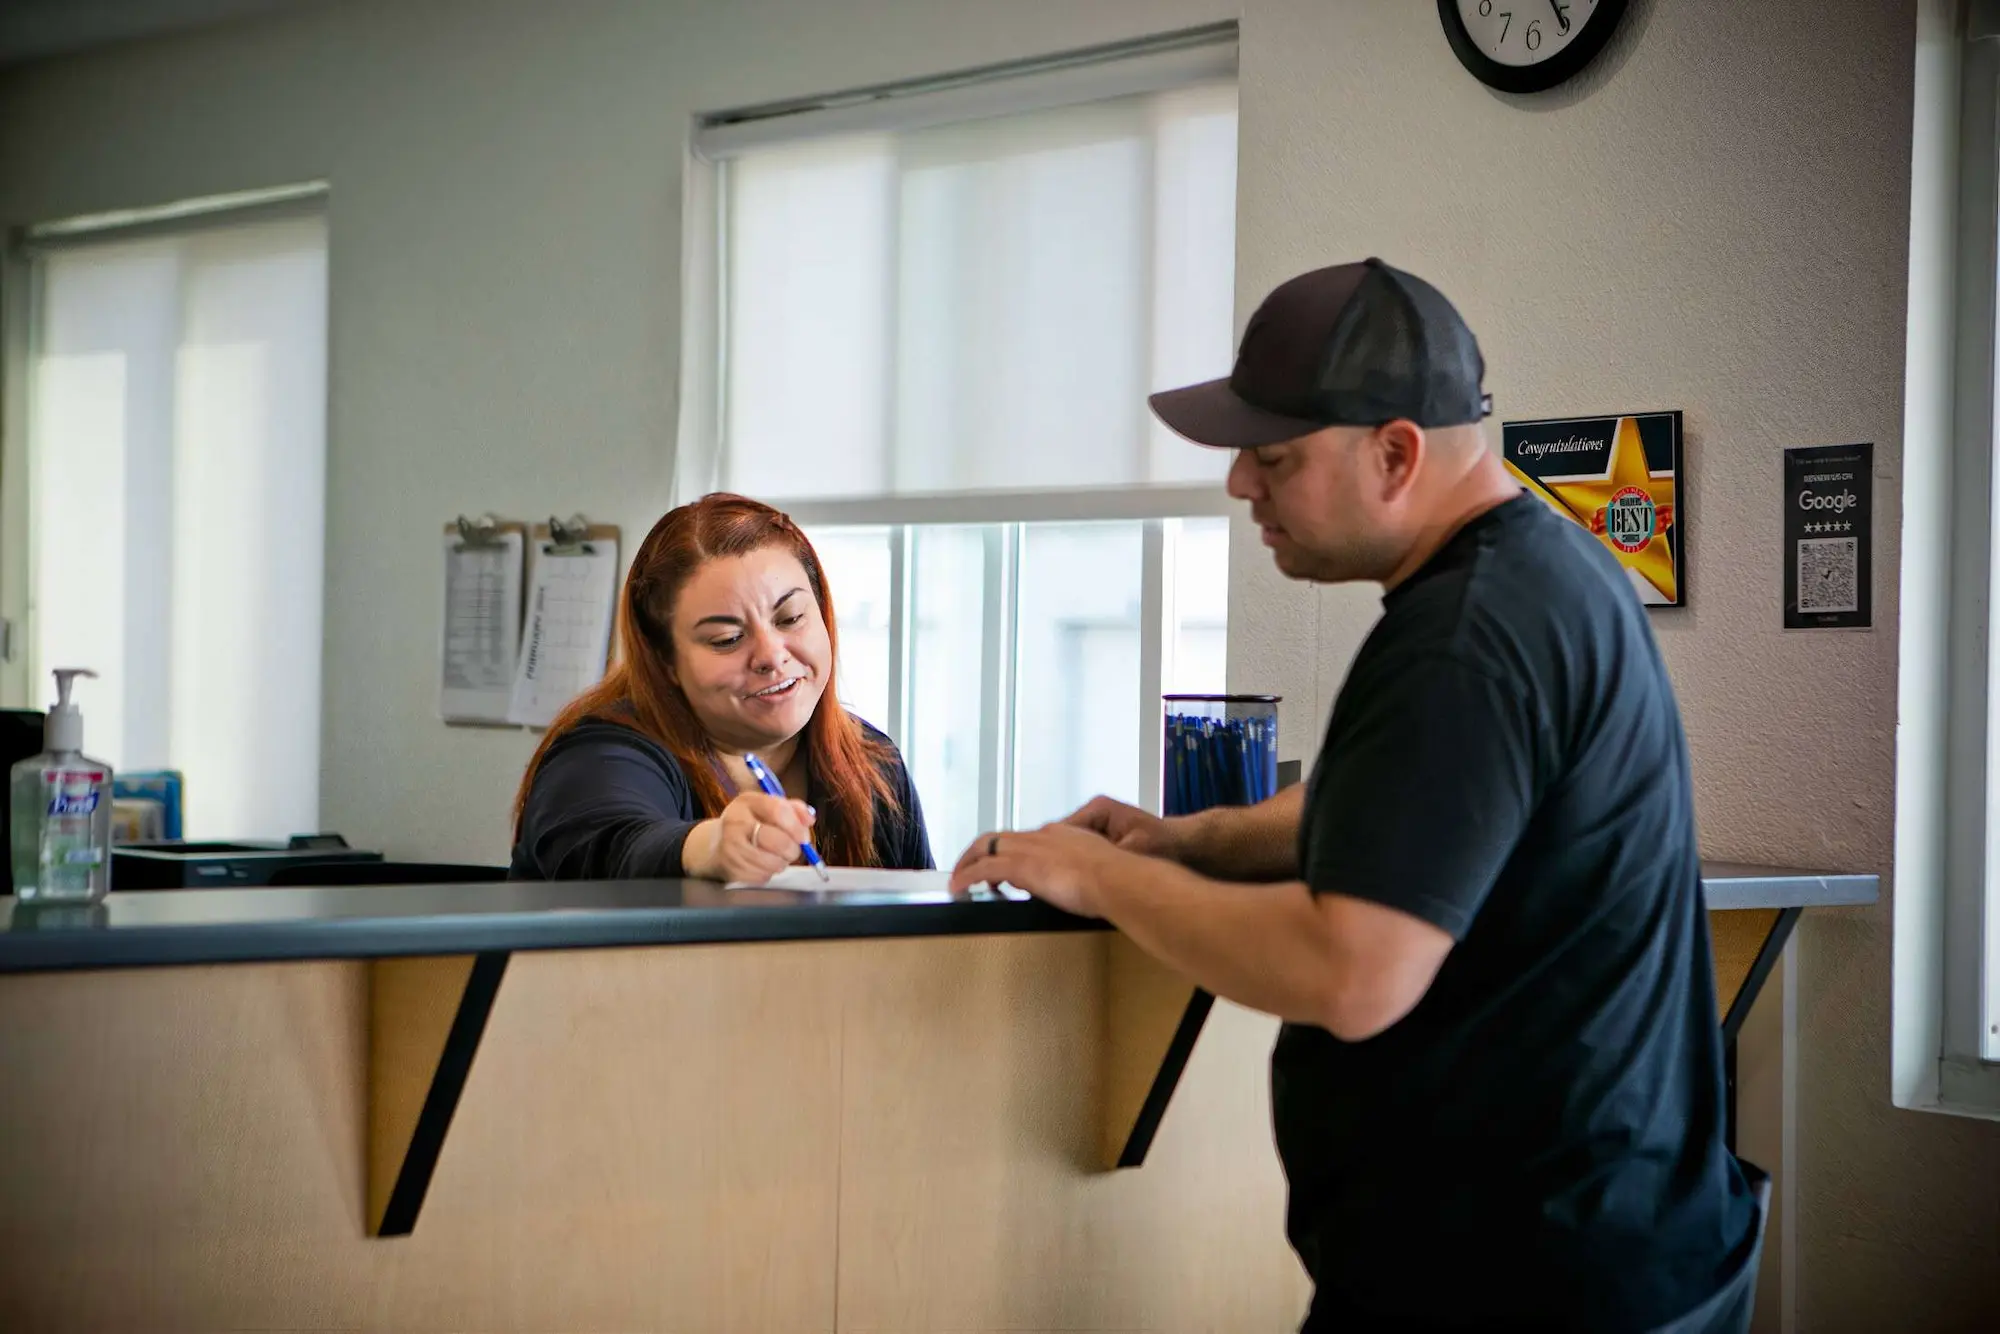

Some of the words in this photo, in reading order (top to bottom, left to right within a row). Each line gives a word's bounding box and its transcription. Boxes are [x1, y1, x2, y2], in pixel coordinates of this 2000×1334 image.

[1499, 12, 1512, 44] 7
[1526, 20, 1541, 51] 6
[1557, 5, 1571, 37] 5
[1517, 434, 1604, 461] Congratulations
[1798, 488, 1857, 514] Google
[1611, 507, 1652, 533] BEST
